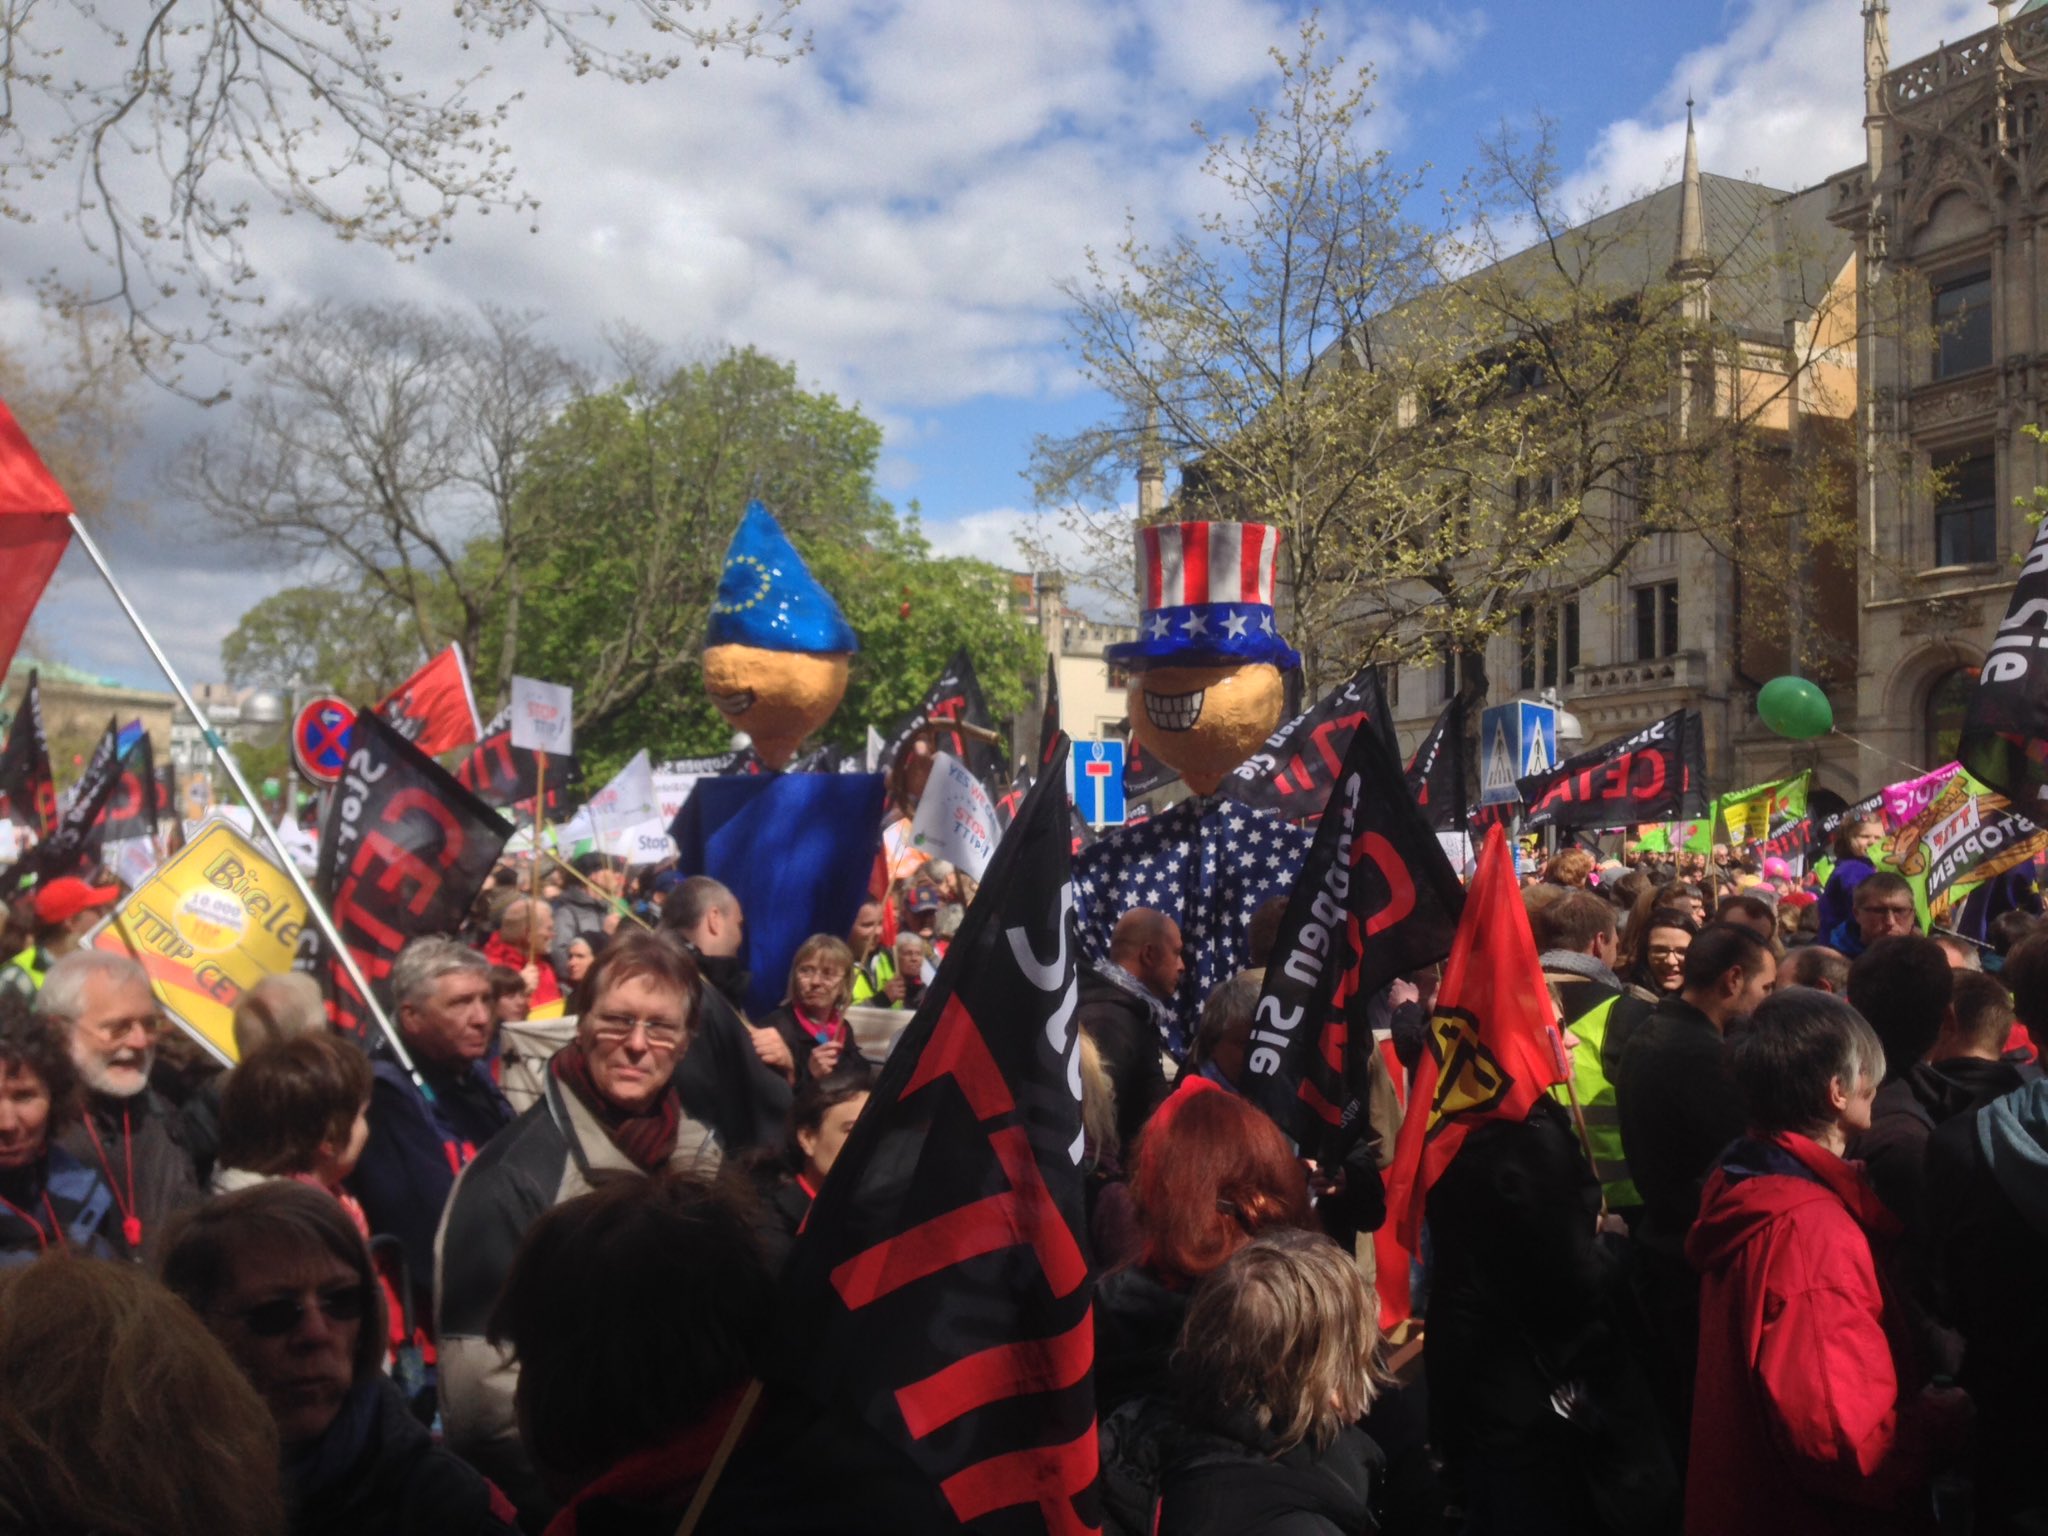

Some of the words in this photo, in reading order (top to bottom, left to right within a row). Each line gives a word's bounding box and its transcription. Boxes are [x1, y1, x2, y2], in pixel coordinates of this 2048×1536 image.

[948, 762, 971, 788] YES
[954, 806, 985, 840] STOP
[638, 834, 669, 851] Stop
